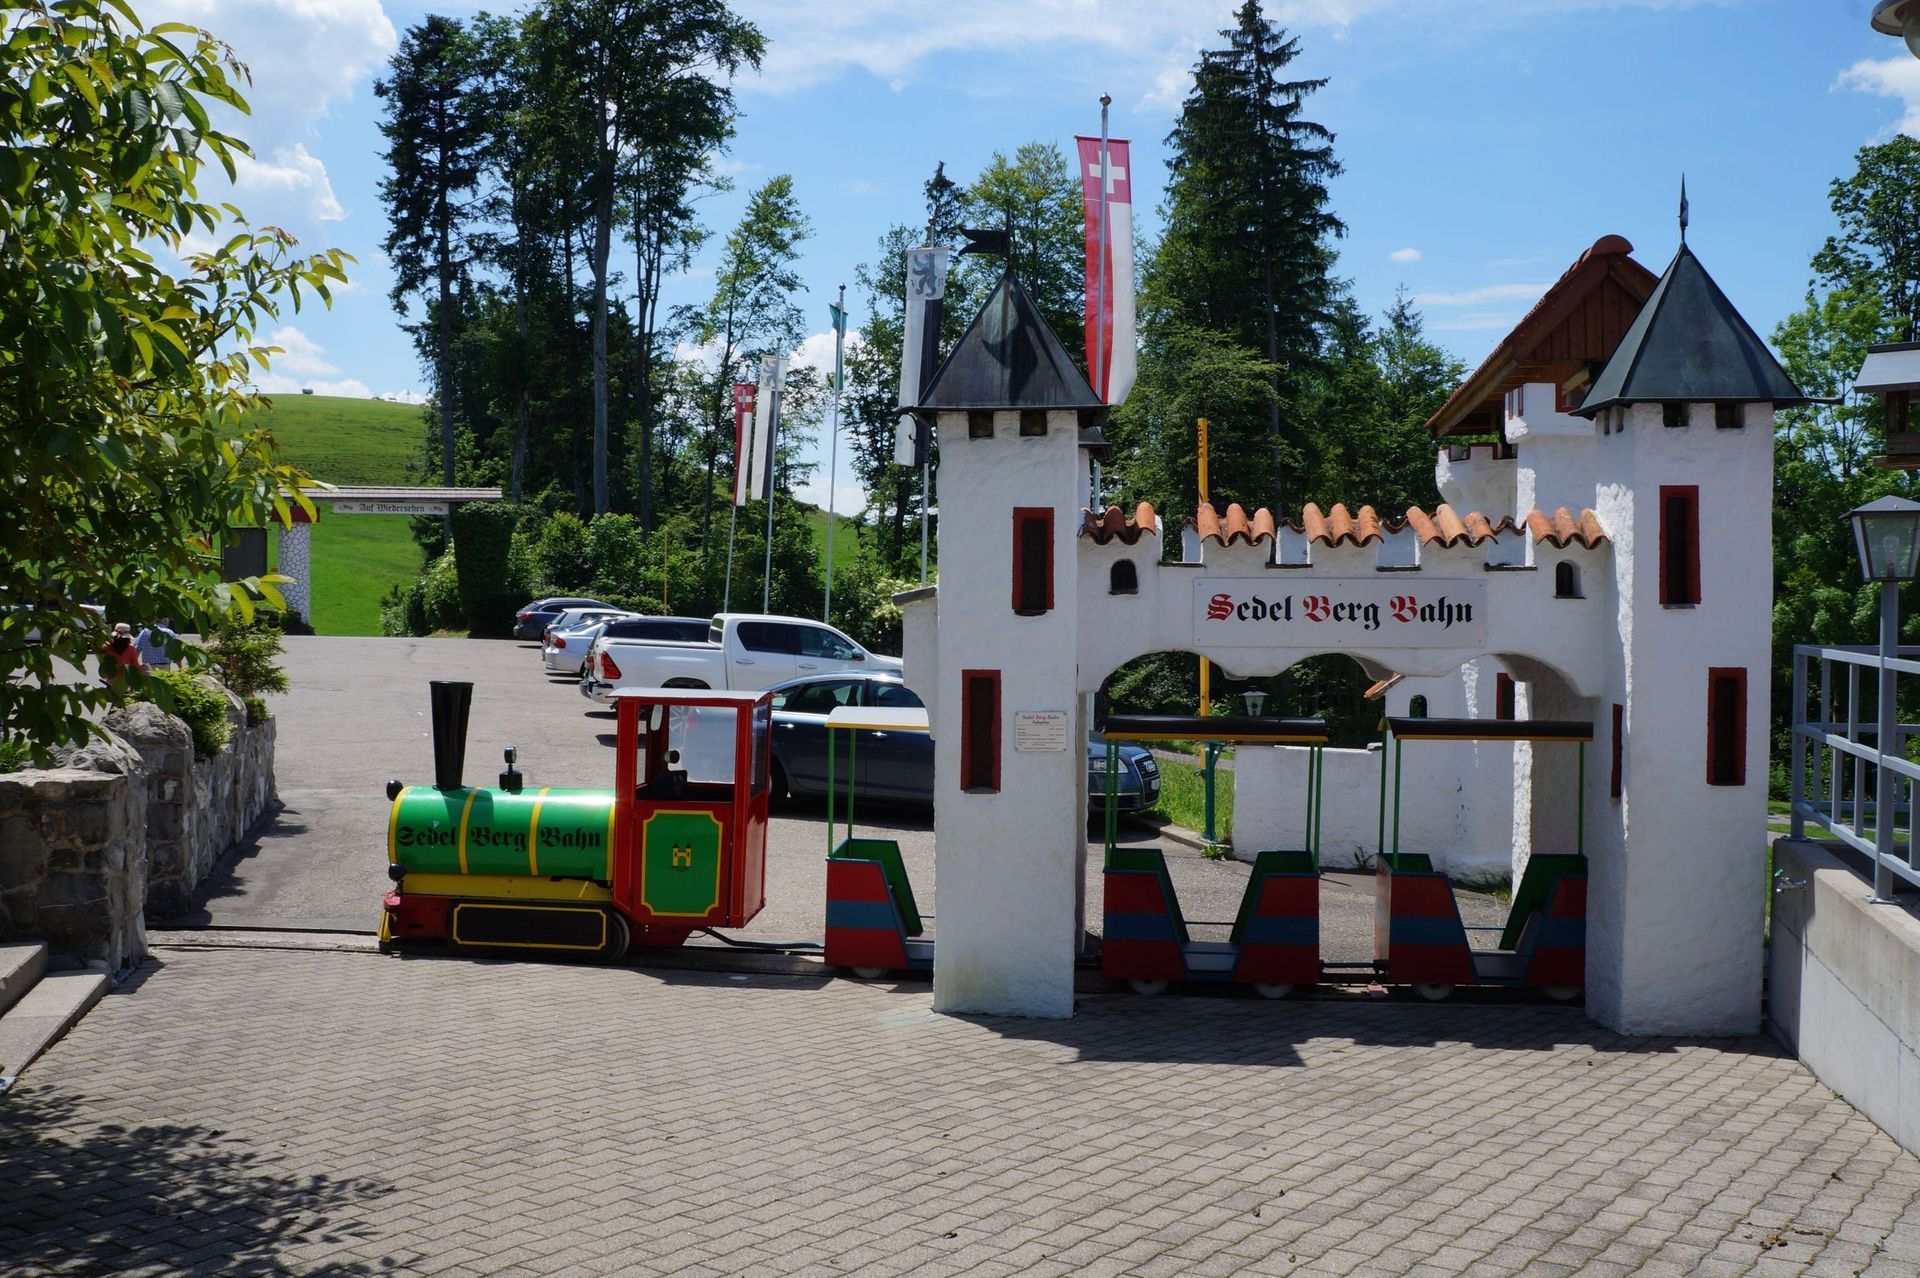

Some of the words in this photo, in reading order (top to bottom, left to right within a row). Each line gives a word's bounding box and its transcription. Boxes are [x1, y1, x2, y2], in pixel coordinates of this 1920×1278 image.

[359, 503, 374, 513] Auf
[377, 503, 425, 513] Wiedersehen
[1206, 593, 1294, 622] Sedel
[1302, 595, 1381, 631] Berg
[1389, 595, 1474, 631] Bahn
[398, 826, 457, 847] Sedel
[471, 826, 527, 853] Berg
[540, 826, 600, 853] Bahn
